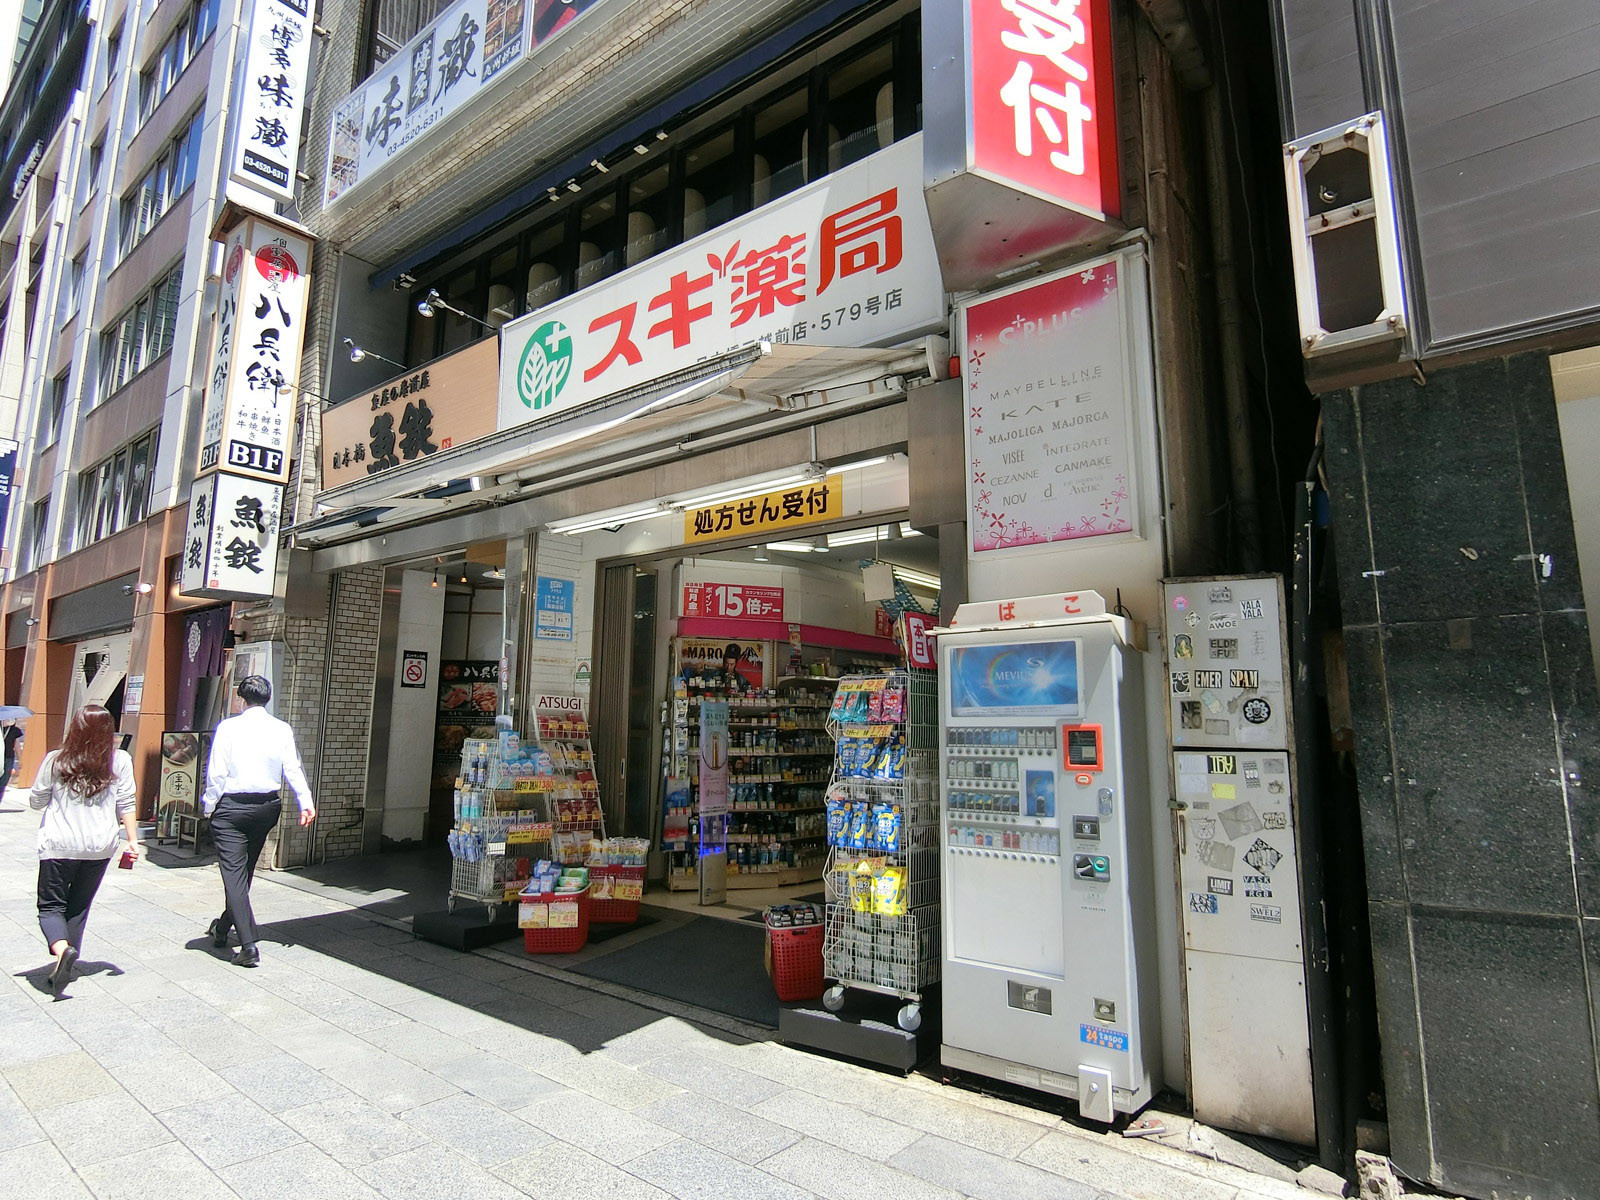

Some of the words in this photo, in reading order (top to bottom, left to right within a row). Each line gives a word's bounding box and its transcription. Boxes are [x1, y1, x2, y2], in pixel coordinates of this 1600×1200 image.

[387, 106, 444, 157] 03-4520-6311
[244, 155, 287, 182] 03-4520-6311
[583, 187, 903, 383] スギ薬局
[990, 366, 1102, 401] MAYBELLINE
[988, 425, 1044, 445] MAJOLICA
[1052, 411, 1109, 430] MAJORCA
[201, 442, 219, 468] B1F
[230, 442, 281, 471] B1F
[332, 443, 366, 470] 日本橋
[990, 469, 1039, 487] CEZANNE
[1055, 456, 1112, 474] CANMAKE
[694, 485, 830, 536] 処方せん受付
[1003, 493, 1027, 507] NOV
[715, 586, 743, 616] 15
[746, 598, 781, 615] 倍デー
[1241, 600, 1261, 610] YALA
[1242, 609, 1263, 619] YALA
[1209, 621, 1237, 630] AWOE
[913, 624, 924, 656] 本日
[995, 670, 1033, 681] MEVIUS
[1195, 671, 1221, 688] EMER
[1230, 669, 1258, 688] SPAM
[538, 695, 582, 710] ATSUGI
[622, 888, 641, 896] 158
[1086, 1029, 1097, 1042] 24
[1099, 1031, 1123, 1044] taspo
